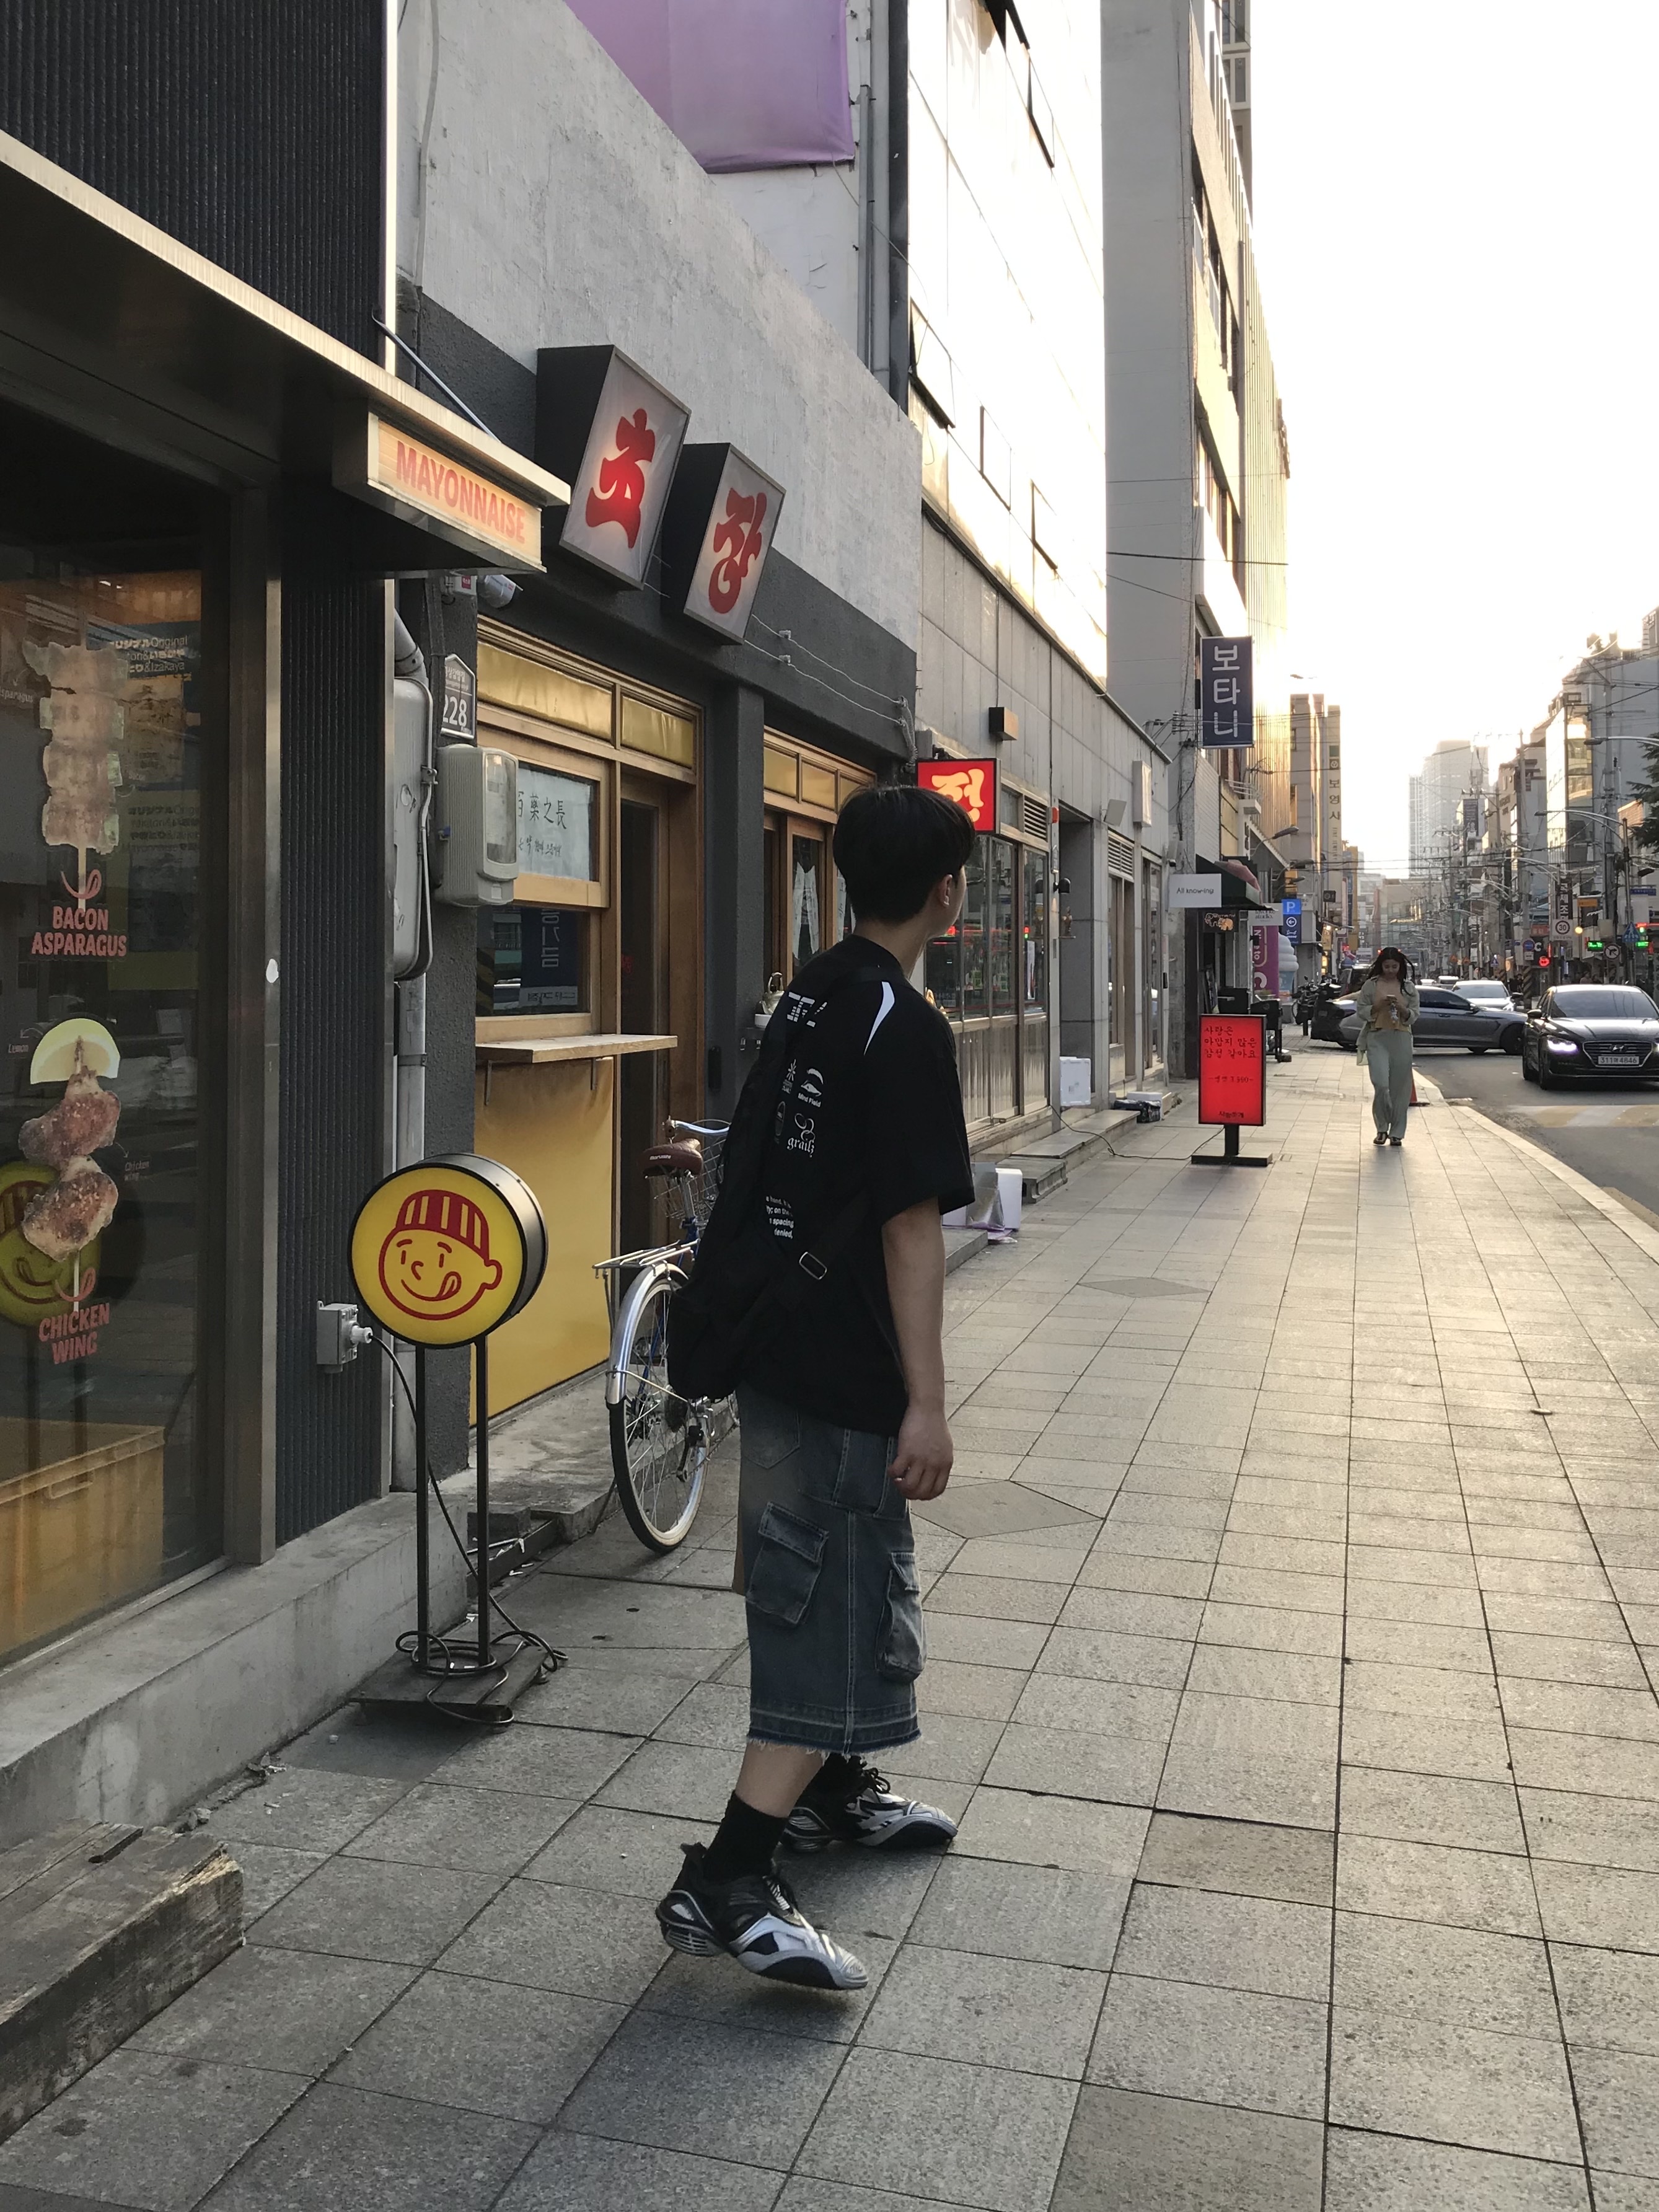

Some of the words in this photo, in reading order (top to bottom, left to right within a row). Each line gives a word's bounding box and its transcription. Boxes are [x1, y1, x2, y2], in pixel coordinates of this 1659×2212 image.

[395, 440, 526, 545] MAYONNAISE
[1212, 645, 1241, 738] 보타니
[1329, 779, 1340, 820] 보영사
[53, 906, 109, 930] BACON
[1286, 901, 1295, 912] P
[32, 932, 127, 956] ASPARAGUS
[773, 1218, 794, 1229] spacing
[38, 1302, 110, 1342] CHICKEN
[52, 1331, 98, 1364] WING
